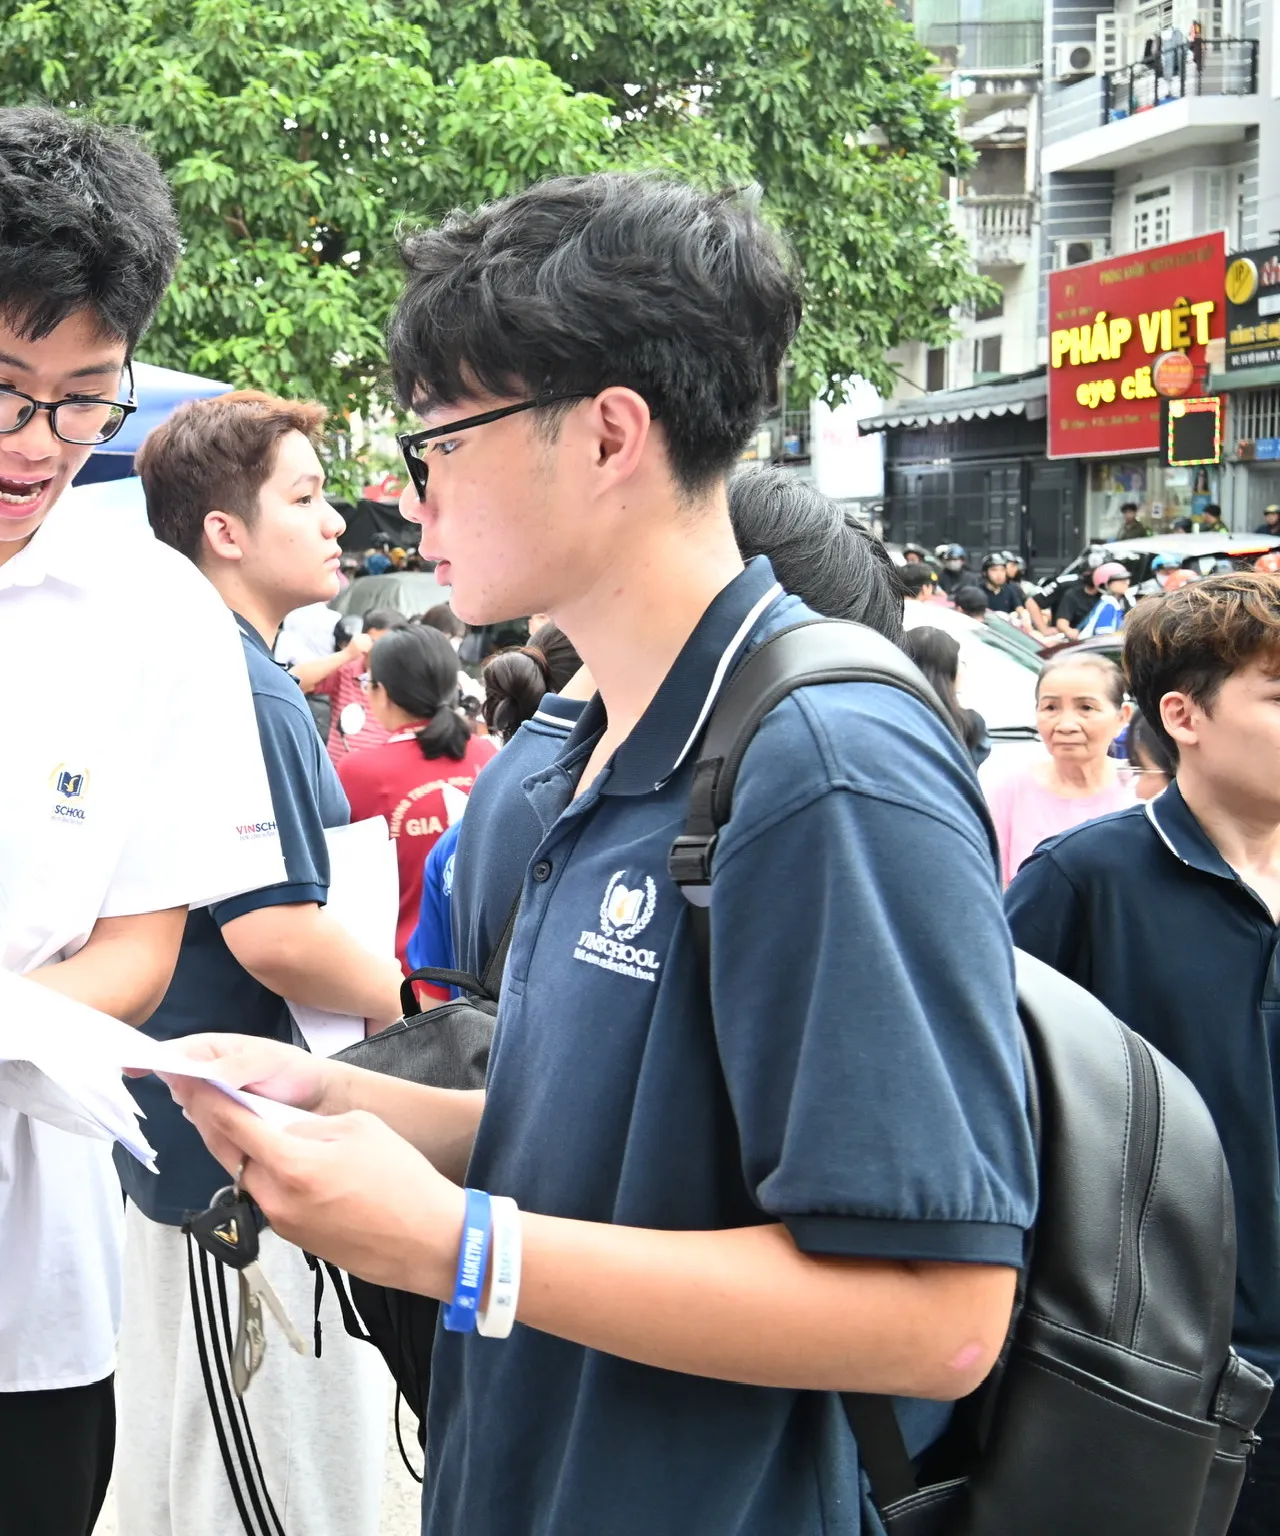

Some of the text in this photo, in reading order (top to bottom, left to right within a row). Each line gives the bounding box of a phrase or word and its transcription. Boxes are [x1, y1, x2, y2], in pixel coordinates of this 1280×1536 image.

[1051, 311, 1132, 368] PHÁP
[1076, 378, 1116, 409] eye
[55, 805, 86, 819] SCHOOL
[406, 816, 444, 836] GIA
